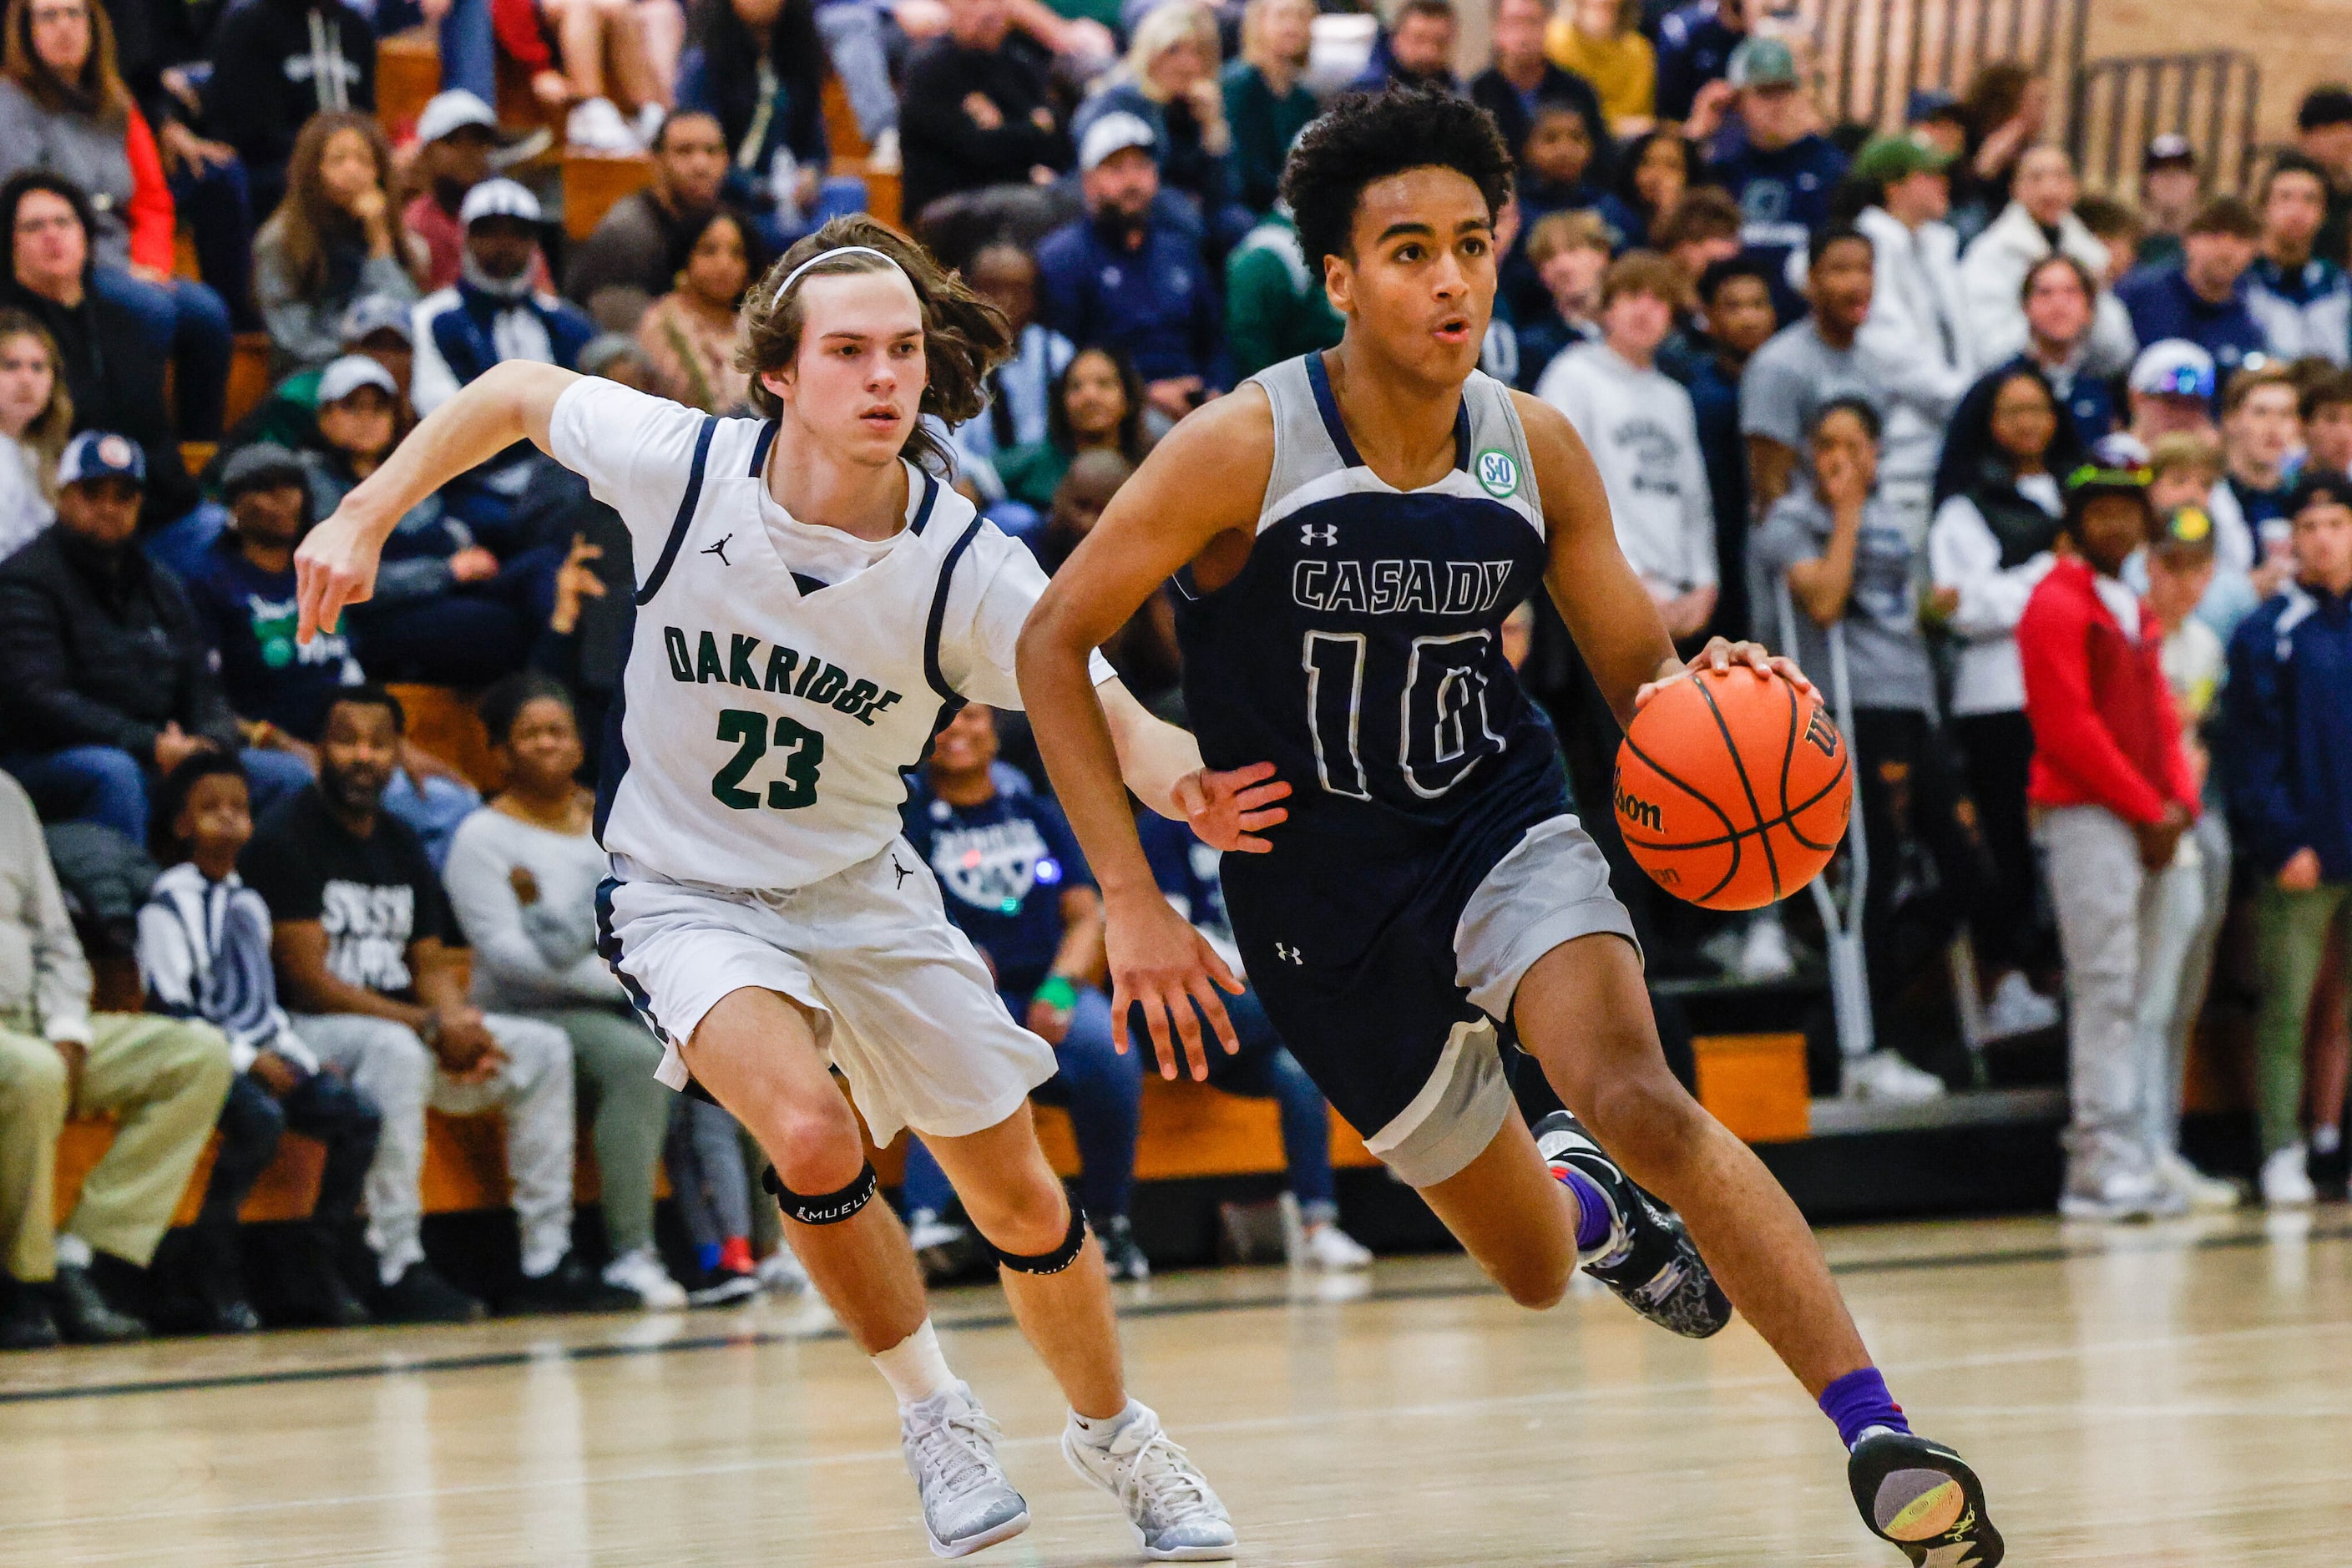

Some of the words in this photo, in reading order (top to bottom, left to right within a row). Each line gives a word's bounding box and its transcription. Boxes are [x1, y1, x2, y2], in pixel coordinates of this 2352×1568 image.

[1292, 559, 1513, 615] CASADY
[664, 625, 903, 726] OAKRIDGE
[1301, 628, 1506, 802] 10
[711, 709, 824, 810] 23
